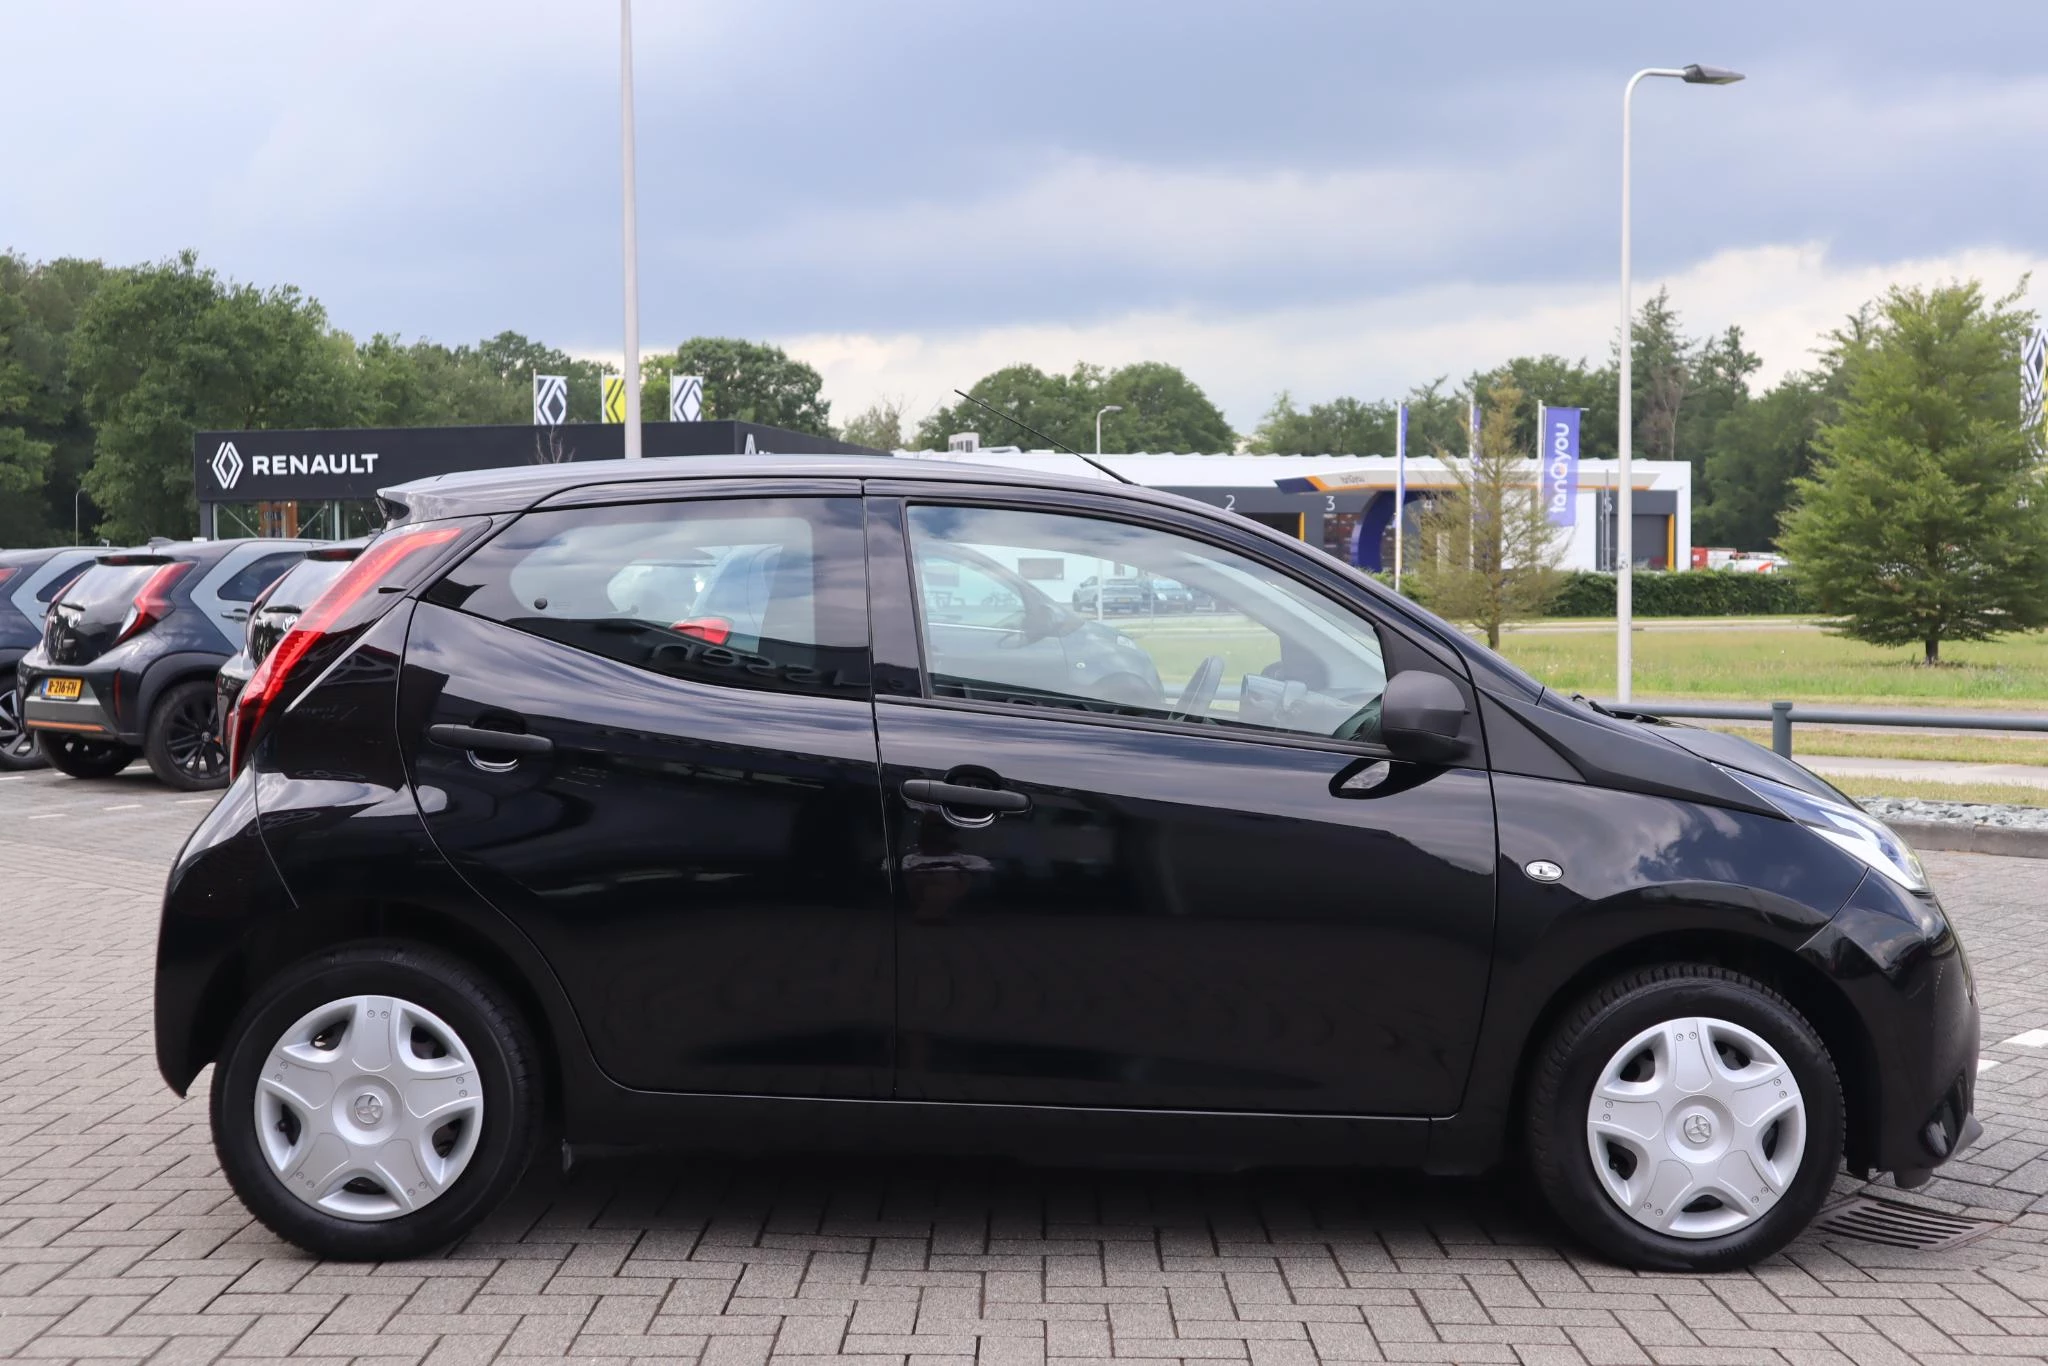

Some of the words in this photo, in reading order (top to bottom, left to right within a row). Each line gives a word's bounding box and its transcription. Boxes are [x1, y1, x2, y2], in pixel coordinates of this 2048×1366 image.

[252, 453, 379, 476] RENAULT
[1225, 494, 1236, 511] 2
[1325, 495, 1336, 511] 3
